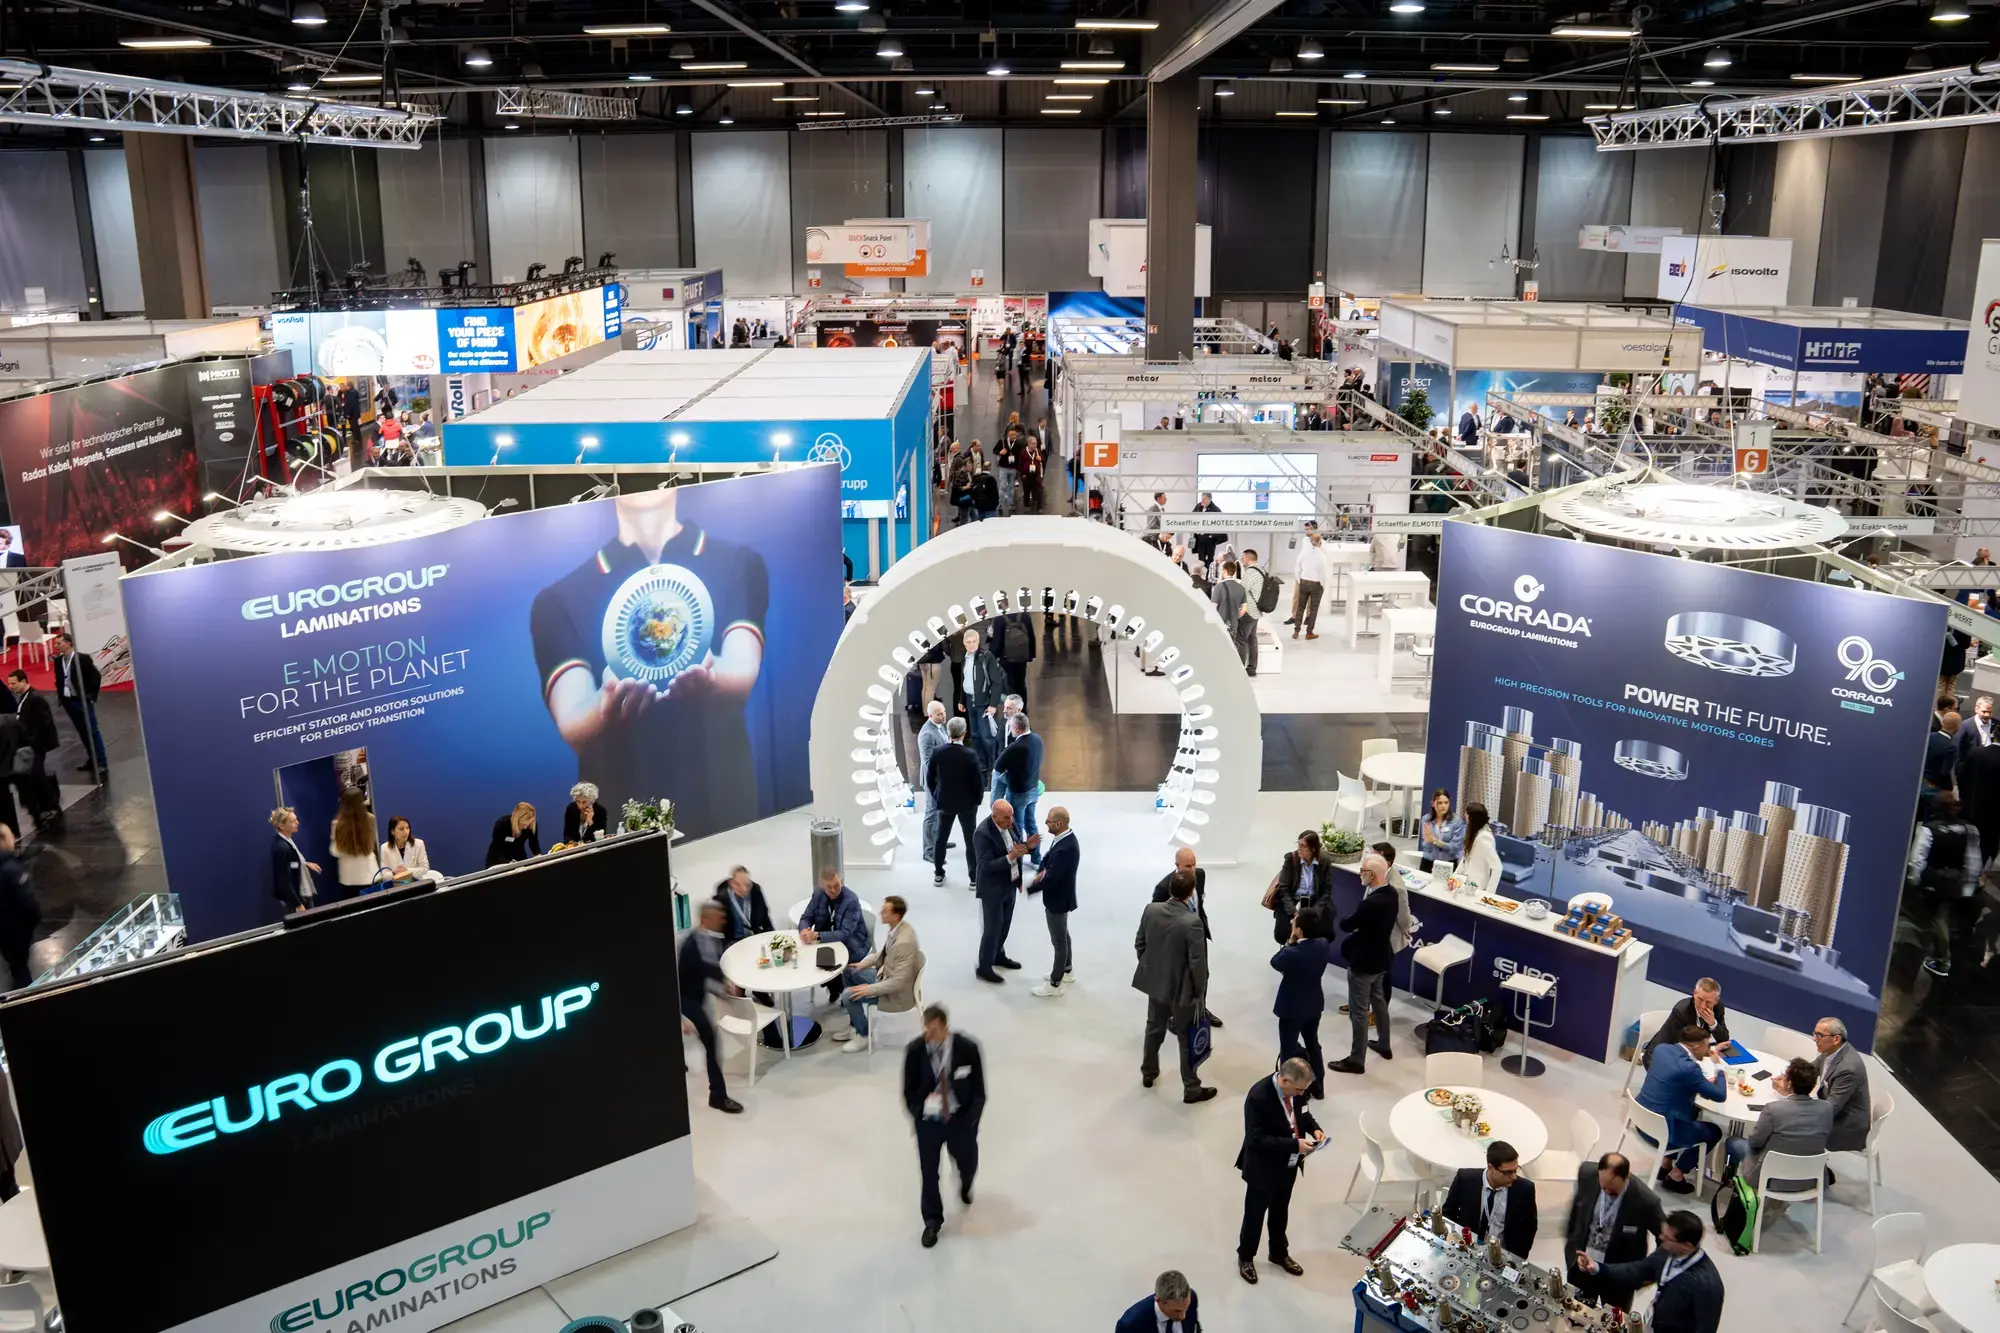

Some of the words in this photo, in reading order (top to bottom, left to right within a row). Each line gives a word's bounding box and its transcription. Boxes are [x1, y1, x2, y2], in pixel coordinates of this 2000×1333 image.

[1731, 267, 1778, 275] isovolta
[685, 281, 703, 301] RUFF
[811, 279, 818, 287] E
[1313, 297, 1320, 306] G
[1527, 292, 1535, 300] H
[447, 327, 474, 337] YOUR
[476, 326, 505, 337] PIECE
[464, 316, 488, 327] FIND
[456, 338, 470, 348] OF
[471, 338, 498, 347] MIND
[1621, 342, 1673, 352] voestalpine
[1805, 341, 1862, 358] Hidria
[1401, 378, 1432, 387] EXPECT
[39, 447, 53, 459] Wir
[54, 441, 71, 454] sind
[71, 440, 81, 451] Ihr
[82, 426, 134, 449] technologischer
[133, 420, 156, 433] Partner
[156, 416, 165, 427] für
[1097, 424, 1103, 440] 1
[1750, 431, 1755, 446] 1
[21, 466, 48, 483] Radox
[48, 458, 73, 475] Kabel,
[72, 451, 106, 468] Magnete,
[105, 441, 135, 458] Sensoren
[136, 436, 148, 449] und
[148, 426, 183, 445] Isolierlacke
[1094, 444, 1109, 466] F
[1743, 450, 1759, 471] G
[1165, 519, 1200, 527] Schaeffler
[241, 564, 448, 621] EUROGROUP
[280, 597, 422, 638] LAMINATIONS
[1459, 593, 1592, 637] CORRADA
[1469, 619, 1521, 637] EUROGROUP
[1521, 630, 1578, 649] LAMINATIONS
[283, 635, 426, 685] E-MOTION
[1837, 635, 1898, 693] 90
[240, 687, 300, 719] FOR
[305, 672, 362, 703] THE
[369, 648, 470, 690] PLANET
[1831, 687, 1894, 707] CORRADA
[253, 722, 307, 743] EFFICIENT
[308, 713, 348, 731] STATOR
[349, 707, 373, 720] AND
[374, 699, 409, 714] ROTOR
[410, 686, 464, 706] SOLUTIONS
[1494, 676, 1518, 688] HIGH
[1520, 682, 1570, 700] PRECISION
[1571, 693, 1604, 708] TOOLS
[1605, 701, 1626, 713] FOR
[1627, 706, 1689, 728] INNOVATIVE
[1691, 722, 1736, 739] MOTORS
[1738, 730, 1775, 748] CORES
[1623, 683, 1700, 716] POWER
[1704, 701, 1742, 725] THE
[1747, 709, 1832, 747] FUTURE.
[299, 731, 322, 744] FOR
[324, 721, 365, 739] ENERGY
[366, 706, 426, 728] TRANSITION
[143, 1058, 363, 1155] EURO
[269, 1211, 552, 1333] EUROGROUP
[326, 1257, 518, 1333] AMINATIONS
